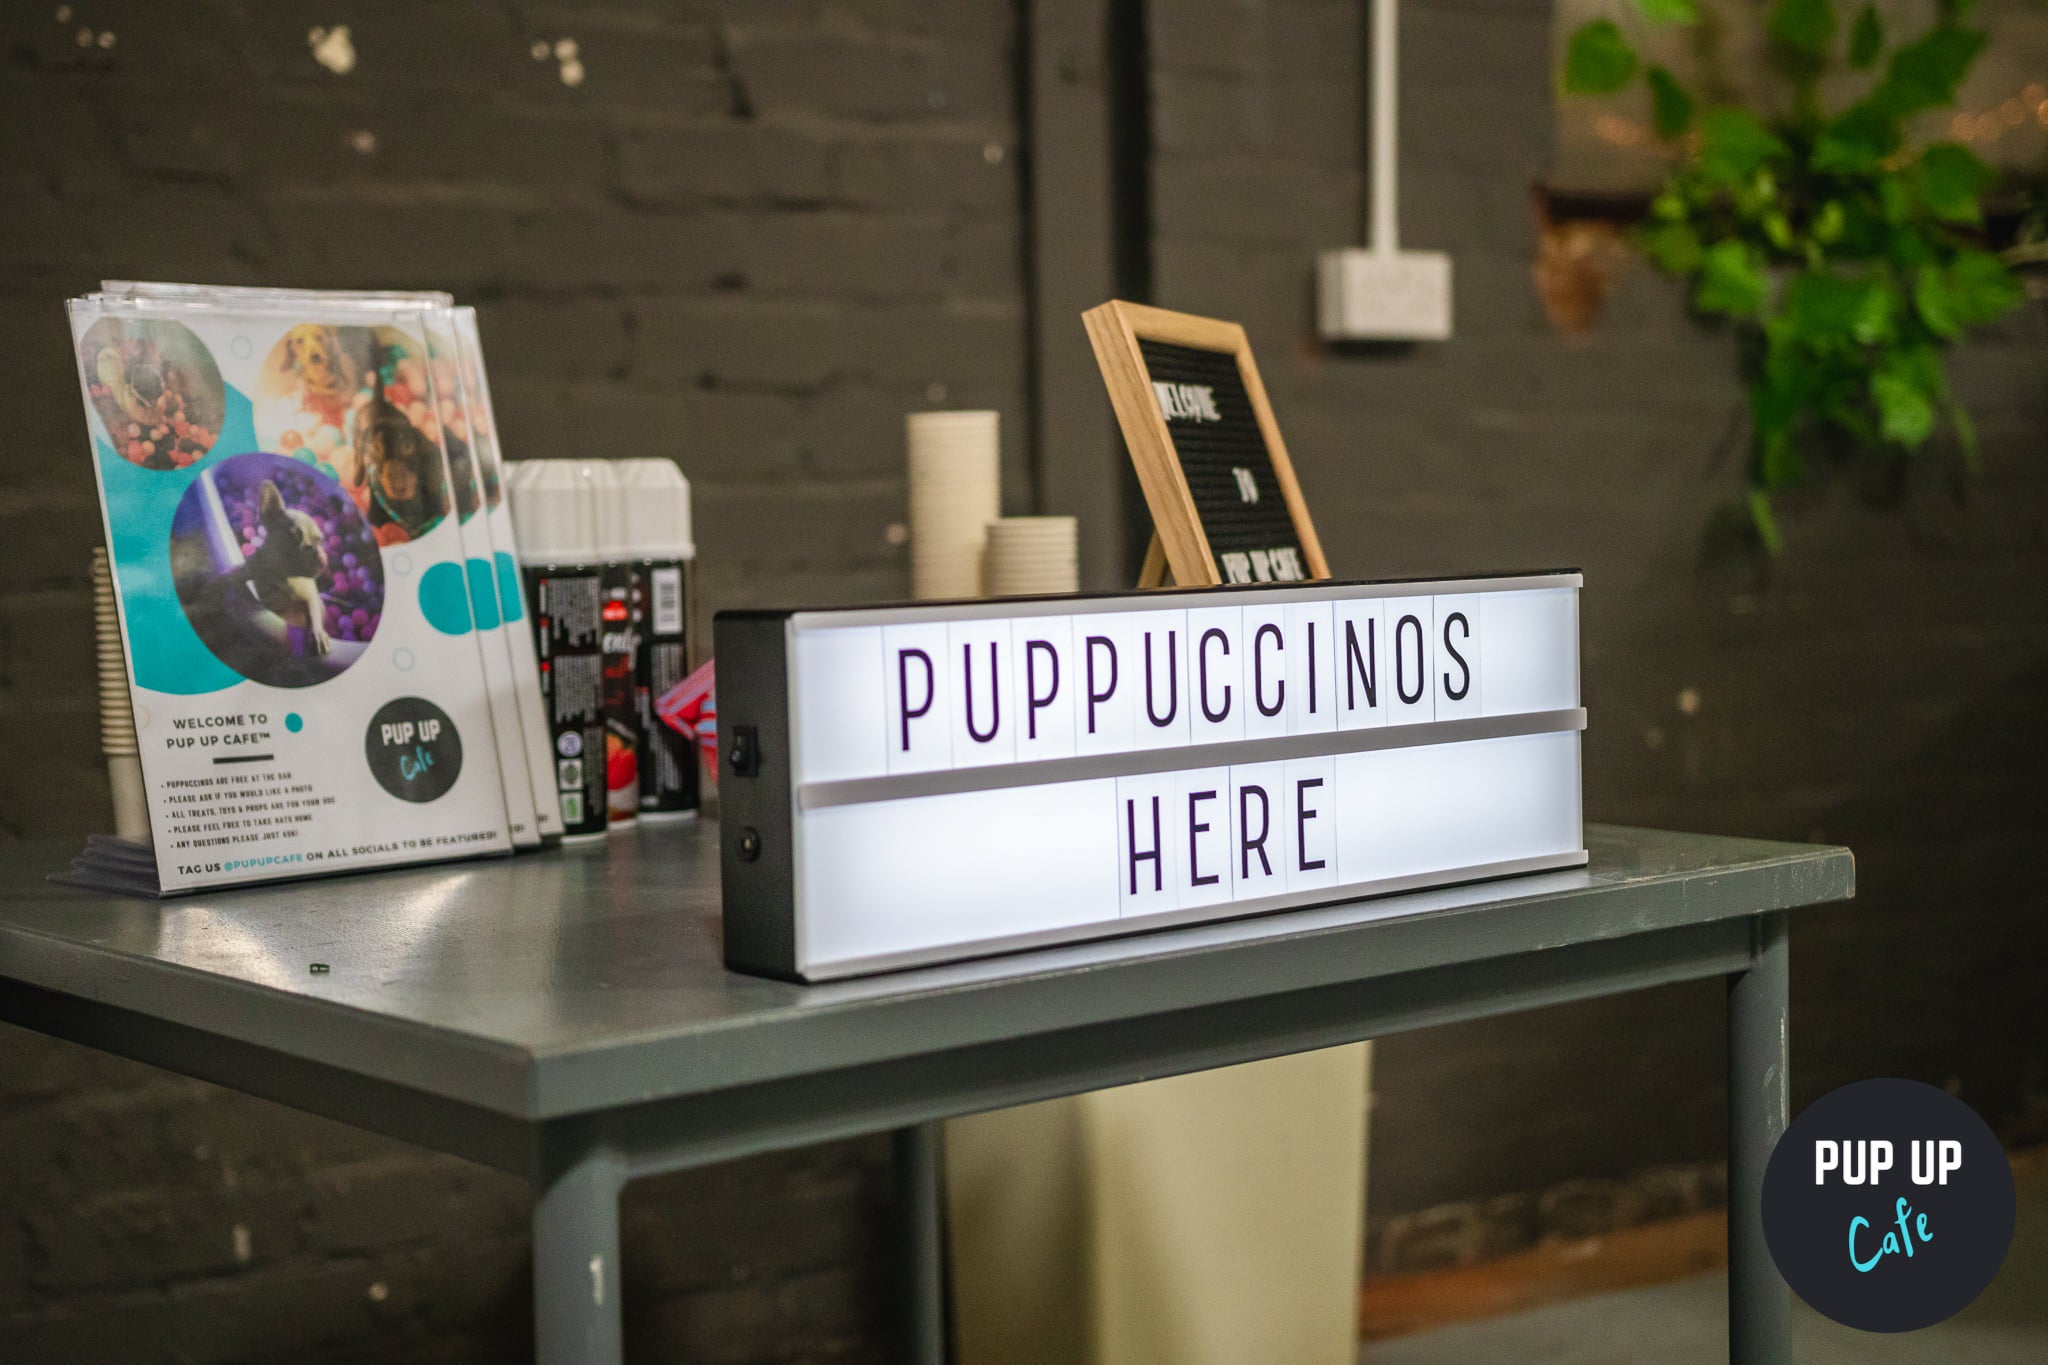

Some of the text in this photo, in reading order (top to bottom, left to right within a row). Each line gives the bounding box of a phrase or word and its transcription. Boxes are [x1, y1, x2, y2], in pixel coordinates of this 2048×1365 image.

[898, 611, 1470, 750] PUPPUCCINOS
[172, 713, 268, 729] WELCOME TO
[166, 737, 195, 749] PUP
[199, 735, 219, 746] UP
[381, 719, 441, 747] PUP UP
[166, 772, 292, 789] PUPPUCCINOS ARE FREE AT THE BAR
[168, 794, 196, 804] PLEASE
[200, 793, 212, 802] ASK
[214, 792, 220, 800] IF
[224, 791, 237, 799] YOU
[240, 789, 263, 798] WOULD
[266, 788, 281, 796] LIKE
[291, 784, 313, 793] PHOTO
[172, 810, 185, 818] ALL
[219, 806, 236, 814] TOYS
[238, 805, 243, 813] &
[245, 803, 268, 812] PROPS
[271, 802, 284, 810] ARE
[286, 800, 300, 808] FOR
[302, 798, 320, 806] YOUR
[174, 814, 312, 834] PLEASE FEEL FREE TO TAKE HATS HOME
[176, 840, 190, 849] ANY
[192, 836, 230, 848] QUESTIONS
[232, 833, 258, 843] PLEASE
[263, 831, 280, 840] JUST
[1127, 777, 1326, 895] HERE
[178, 830, 497, 875] TAG US @PUPUPCAFE ON ALL SOCIALS TO BE FEATURED!
